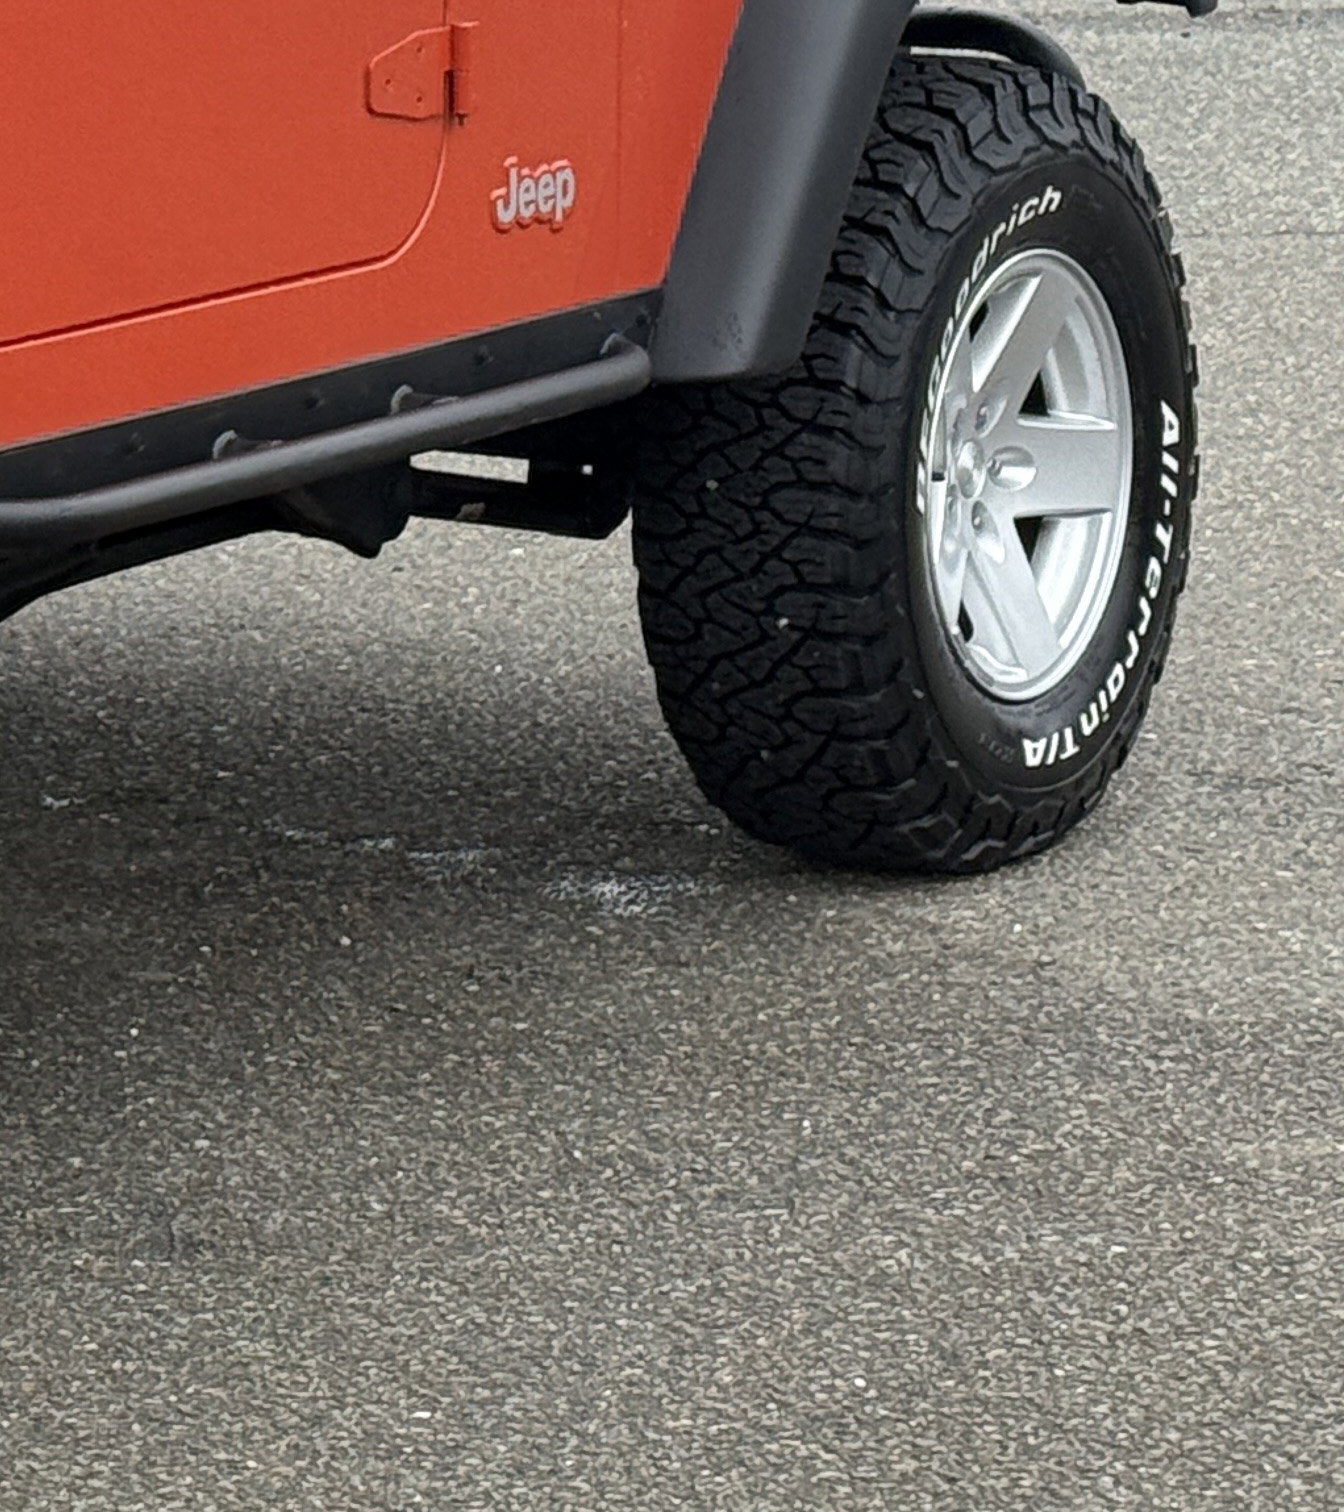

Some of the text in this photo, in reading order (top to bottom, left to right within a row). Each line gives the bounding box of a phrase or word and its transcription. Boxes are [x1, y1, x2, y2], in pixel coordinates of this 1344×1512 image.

[493, 158, 577, 231] Jeep
[1022, 400, 1181, 769] All-Terrain T/A
